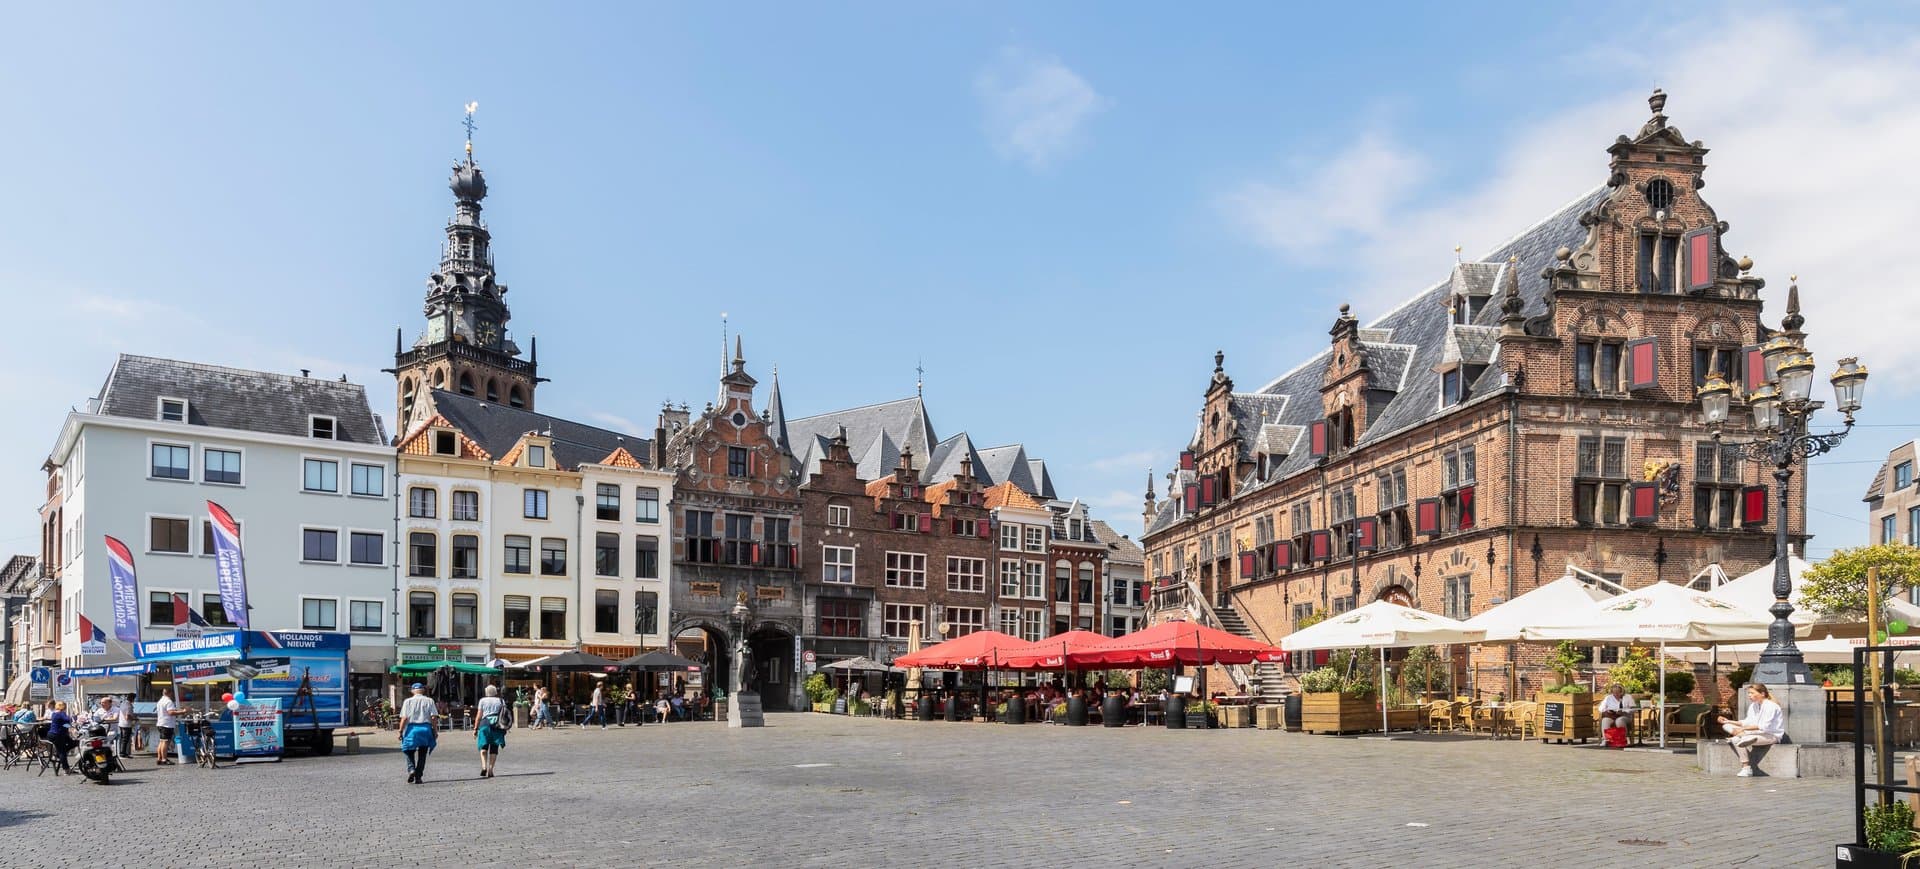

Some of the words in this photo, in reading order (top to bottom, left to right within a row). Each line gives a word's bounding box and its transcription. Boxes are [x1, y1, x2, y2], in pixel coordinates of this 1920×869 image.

[195, 638, 206, 649] VAN
[206, 634, 235, 649] KABELJAUW
[280, 633, 323, 642] HOLLANDSE
[175, 663, 196, 673] HEEL
[196, 659, 231, 670] HOLLAND
